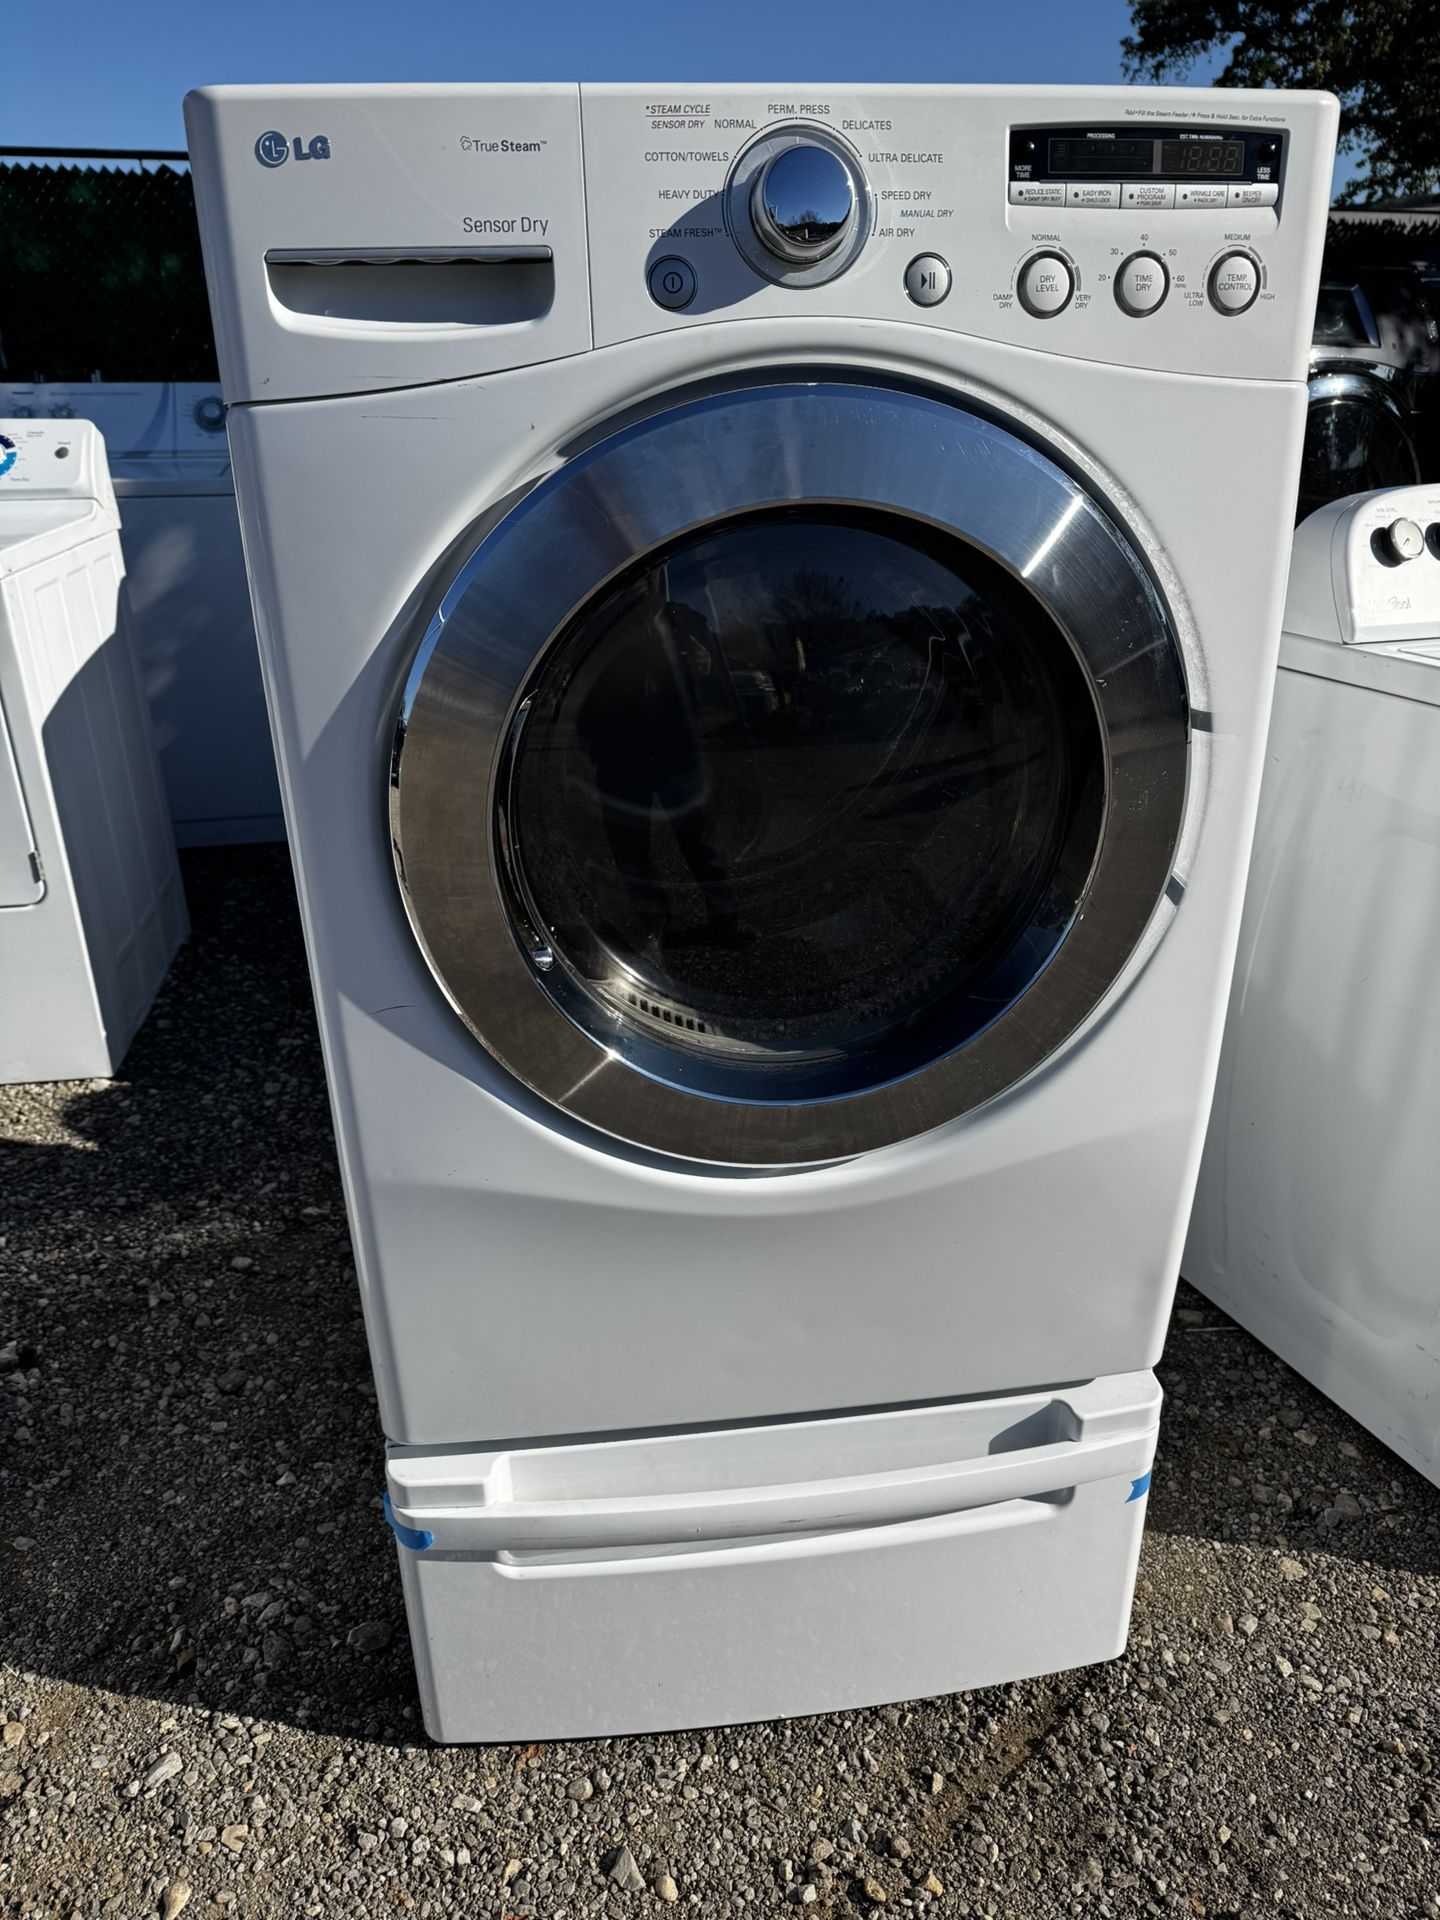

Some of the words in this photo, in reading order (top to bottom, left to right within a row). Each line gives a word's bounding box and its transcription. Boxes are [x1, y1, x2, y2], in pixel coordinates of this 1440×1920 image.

[683, 104, 711, 114] CYCLE
[768, 104, 798, 114] PERM.
[799, 104, 830, 115] PRESS
[651, 120, 686, 129] SENSOR
[687, 120, 706, 129] DRY
[714, 119, 757, 129] NORMAL
[842, 120, 892, 131] DELICATES
[293, 135, 331, 161] LG
[473, 140, 499, 152] True
[644, 151, 729, 162] COTTON/TOWELS
[868, 153, 898, 163] ULTRA
[900, 153, 944, 164] DELICATE
[658, 190, 691, 200] HEAVY
[692, 189, 719, 200] DUTY
[881, 191, 911, 200] SPEED
[913, 191, 932, 200] DRY
[1025, 188, 1045, 196] REDUCE
[900, 209, 935, 218] MANUAL
[937, 209, 954, 218] DRY
[463, 217, 517, 233] Sensor
[521, 216, 549, 236] Dry
[649, 228, 684, 238] STEAM
[878, 228, 894, 237] AIR
[896, 228, 915, 237] DRY
[1140, 233, 1149, 241] 40
[1224, 233, 1251, 241] MEDIUM
[1040, 275, 1056, 283] DRY
[1134, 274, 1153, 283] TIME
[1035, 284, 1060, 293] LEVEL
[1135, 283, 1152, 292] DRY
[1218, 282, 1253, 291] CONTROL
[1075, 294, 1092, 302] VERY
[999, 301, 1013, 309] DRY
[1189, 299, 1204, 307] LOW
